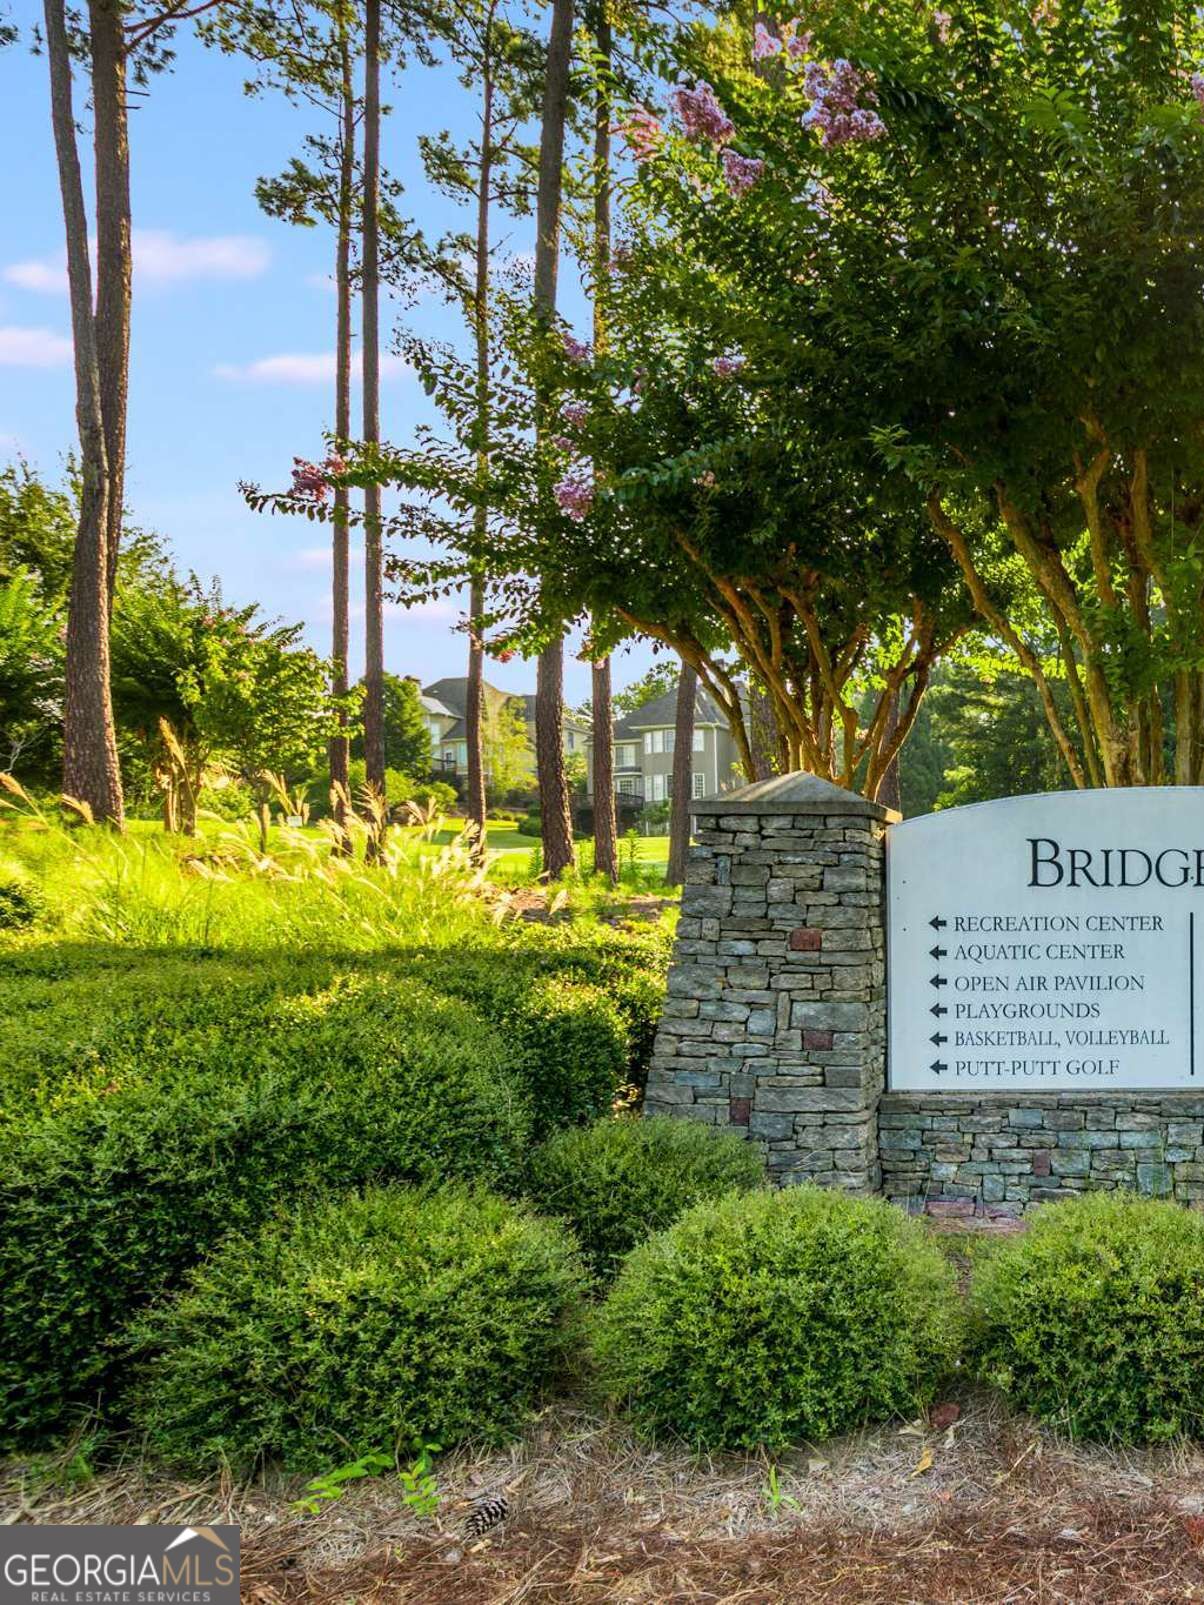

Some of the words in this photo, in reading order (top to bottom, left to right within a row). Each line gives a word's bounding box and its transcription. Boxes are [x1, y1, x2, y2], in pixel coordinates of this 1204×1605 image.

[954, 916, 1080, 932] RECREATION
[1085, 915, 1165, 932] CENTER
[954, 944, 1041, 963] AQUATIC
[1046, 944, 1125, 960] CENTER
[954, 976, 1010, 992] OPEN
[1015, 975, 1048, 991] AIR
[1054, 975, 1145, 991] PAVILION
[955, 1002, 1101, 1019] PLAYGROUNDS
[954, 1030, 1061, 1048] BASKETBALL,
[1065, 1030, 1170, 1046] VOLLEYBALL
[955, 1060, 1061, 1076] PUTT-PUTT
[1066, 1059, 1120, 1075] GOLF
